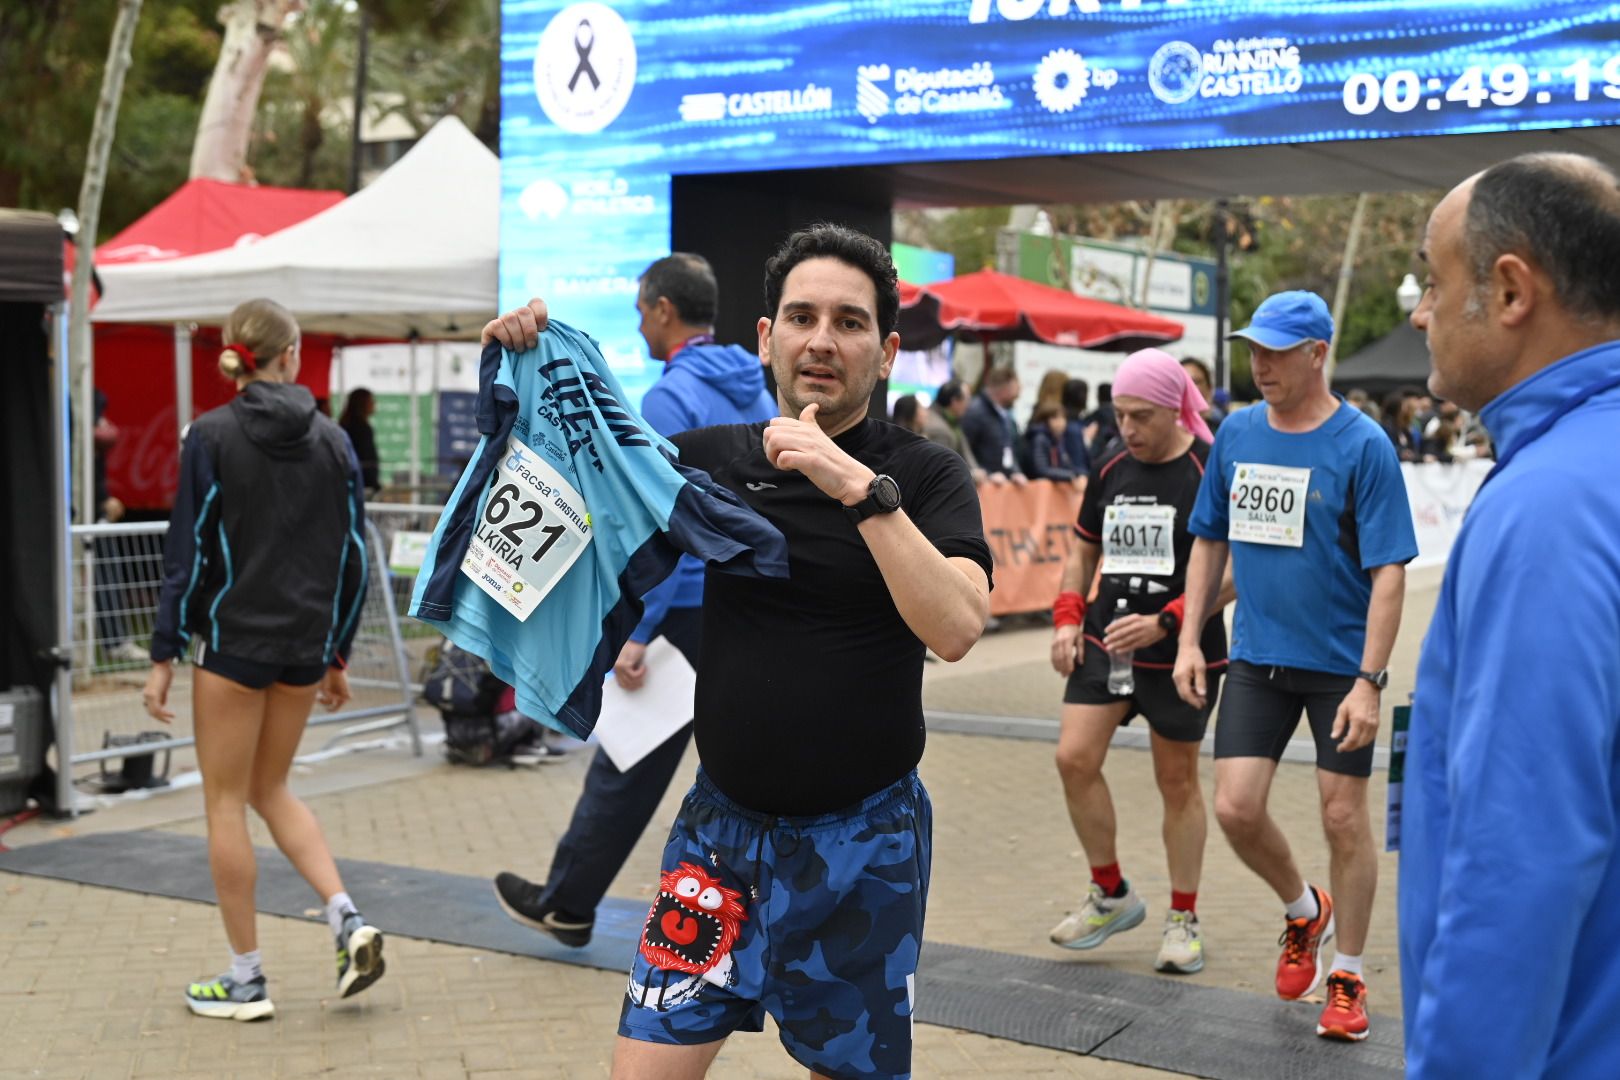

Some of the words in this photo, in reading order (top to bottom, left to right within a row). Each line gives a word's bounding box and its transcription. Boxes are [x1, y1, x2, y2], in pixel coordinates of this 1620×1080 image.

[1202, 46, 1301, 75] RUNNING
[895, 61, 994, 94] Diputació
[1091, 67, 1118, 91] bp
[1201, 70, 1303, 98] CASTELLO
[728, 82, 832, 117] CASTELLÓN
[895, 92, 922, 115] de
[537, 357, 599, 432] LIFE
[1236, 484, 1295, 514] 2960
[485, 469, 567, 563] 621
[554, 497, 588, 534] CASTELLÓ
[1247, 512, 1278, 523] SALVA
[985, 525, 1073, 567] THLET
[1109, 524, 1163, 547] 4017
[1109, 547, 1148, 556] ANTONIO
[1149, 548, 1167, 557] VTE
